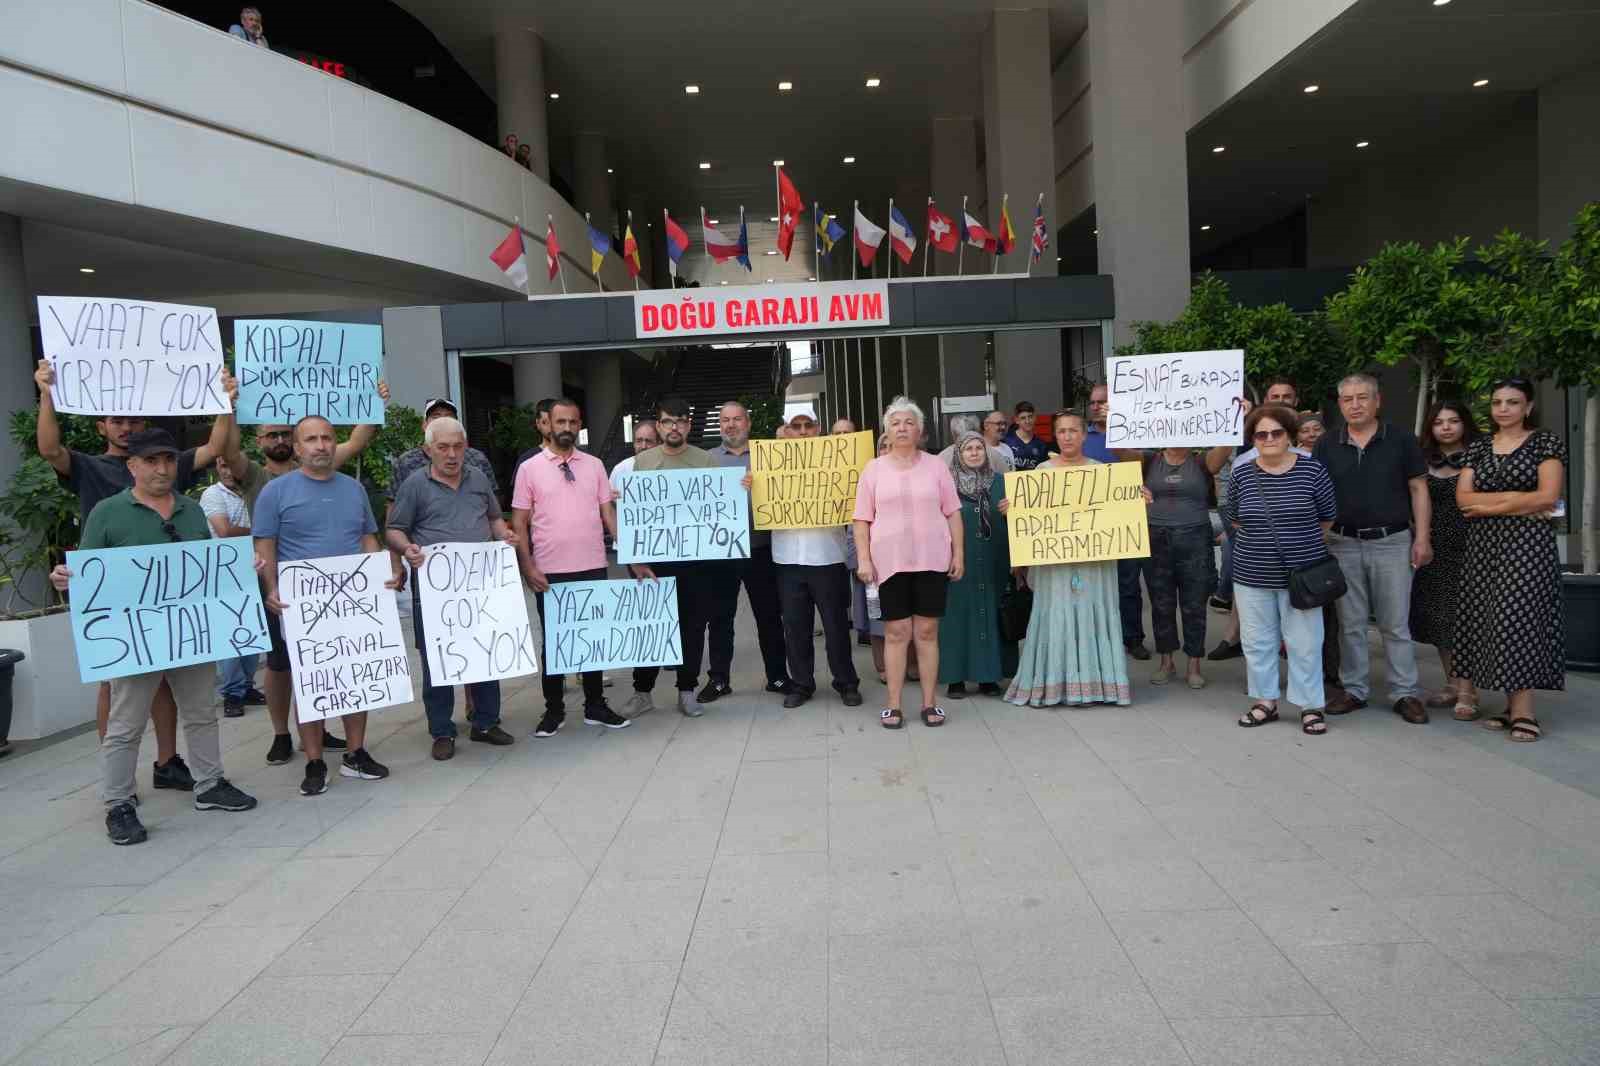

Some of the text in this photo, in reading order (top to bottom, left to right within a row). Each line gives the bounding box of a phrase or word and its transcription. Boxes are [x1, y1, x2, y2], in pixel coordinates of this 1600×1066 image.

[49, 302, 216, 356] VAAT ÇOK
[642, 293, 883, 332] DOĞU GARAJI AVM
[245, 324, 345, 365] KAPALI
[51, 354, 225, 412] İCRAAT YOK
[242, 362, 379, 391] DÜKKANLARI
[1113, 359, 1183, 394] ESNAF
[255, 391, 372, 424] AÇTIRIN
[755, 437, 858, 472] İNSANLARI
[622, 474, 724, 504] KİRA VAR!
[1013, 463, 1112, 509] ADALETLİ
[687, 500, 738, 523] VAR!
[1015, 508, 1104, 537] ADALET
[633, 522, 748, 558] HİZMET YOK
[1032, 521, 1141, 560] ARAMAYIN
[81, 543, 243, 614] 2 YILDIR
[427, 544, 519, 592] ÖDEME
[441, 595, 499, 637] ÇOK
[610, 579, 677, 623] YANDIK
[83, 602, 212, 669] SİFTAH
[296, 631, 400, 667] FESTİVAL
[435, 623, 536, 681] İŞ YOK
[608, 619, 679, 664] DONDUK
[299, 655, 411, 697] HALK PAZARI
[313, 681, 392, 717] ÇARŞISI
